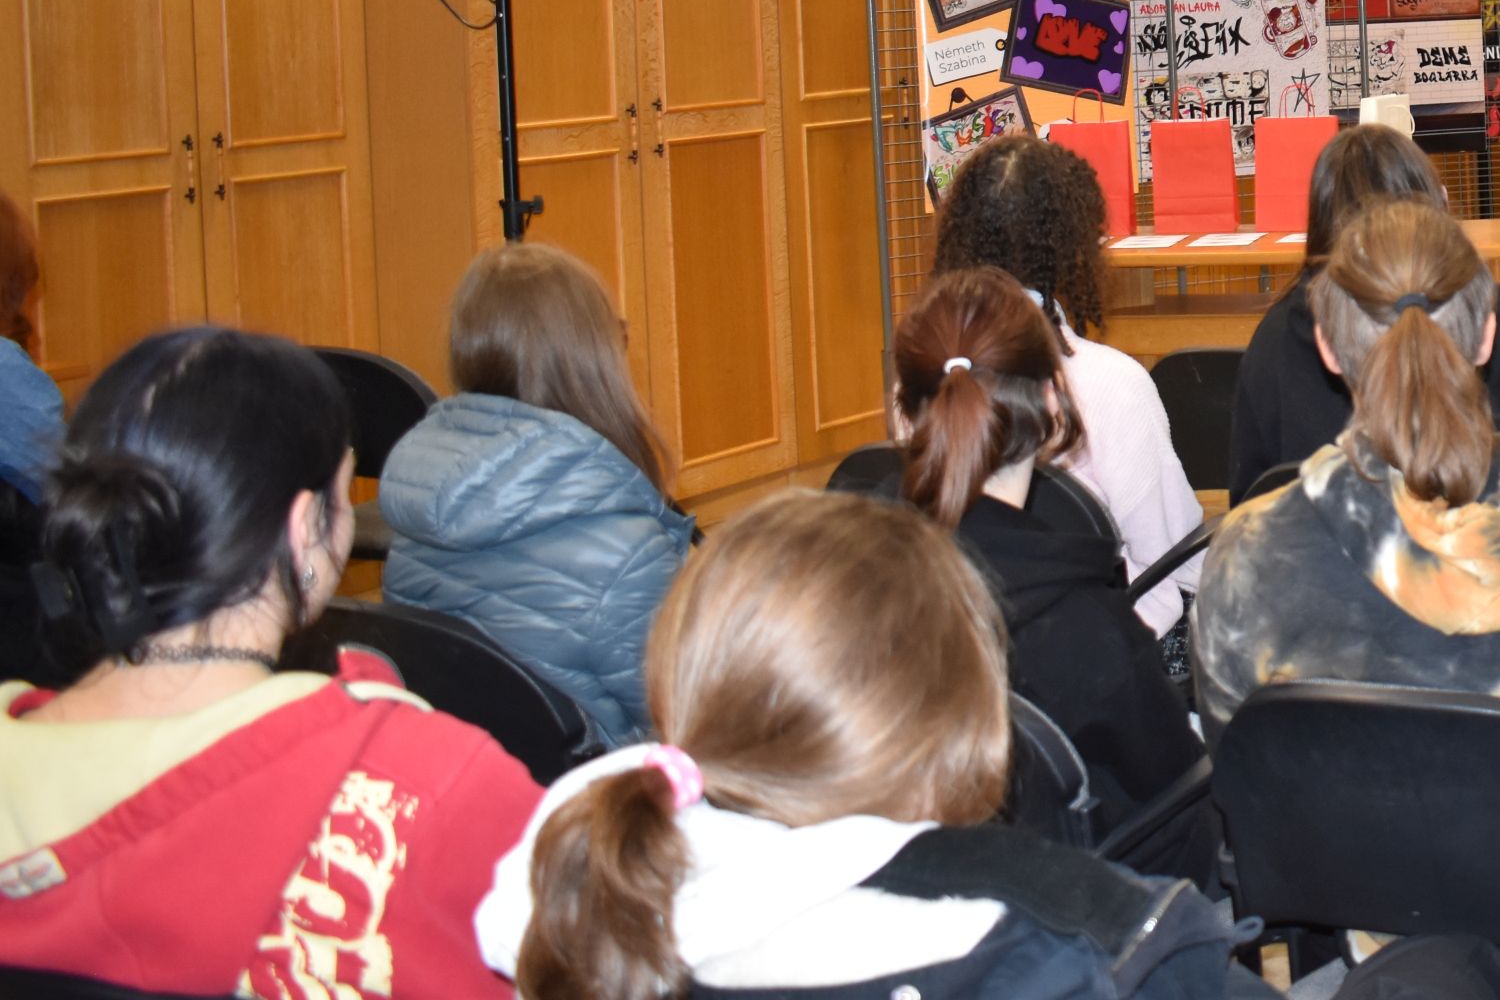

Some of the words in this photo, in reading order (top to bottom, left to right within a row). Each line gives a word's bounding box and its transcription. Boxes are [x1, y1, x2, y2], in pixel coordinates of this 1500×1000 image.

[1140, 1, 1186, 15] ADORÁN
[1188, 1, 1221, 13] LAURA
[935, 39, 986, 61] Németh
[1417, 45, 1471, 68] DEME
[938, 52, 987, 74] Szabina
